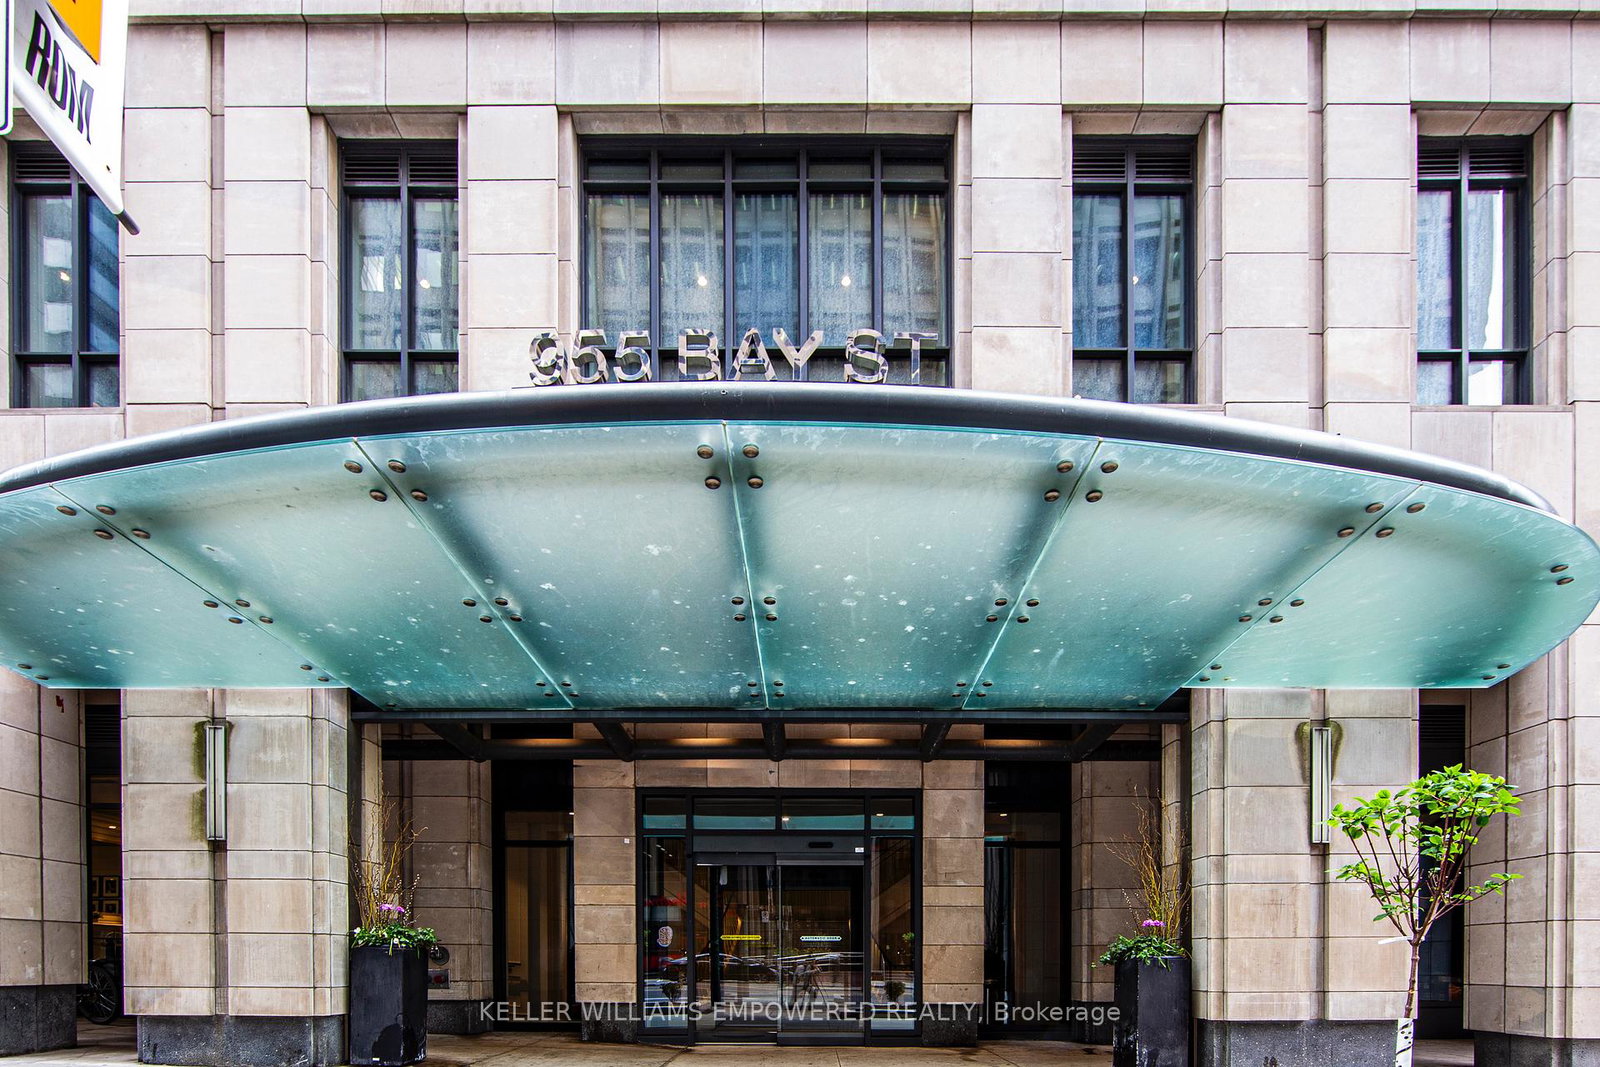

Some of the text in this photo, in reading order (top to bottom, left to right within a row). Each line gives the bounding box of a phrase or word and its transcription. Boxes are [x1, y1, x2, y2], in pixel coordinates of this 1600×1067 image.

[528, 328, 940, 385] 955 BAY ST
